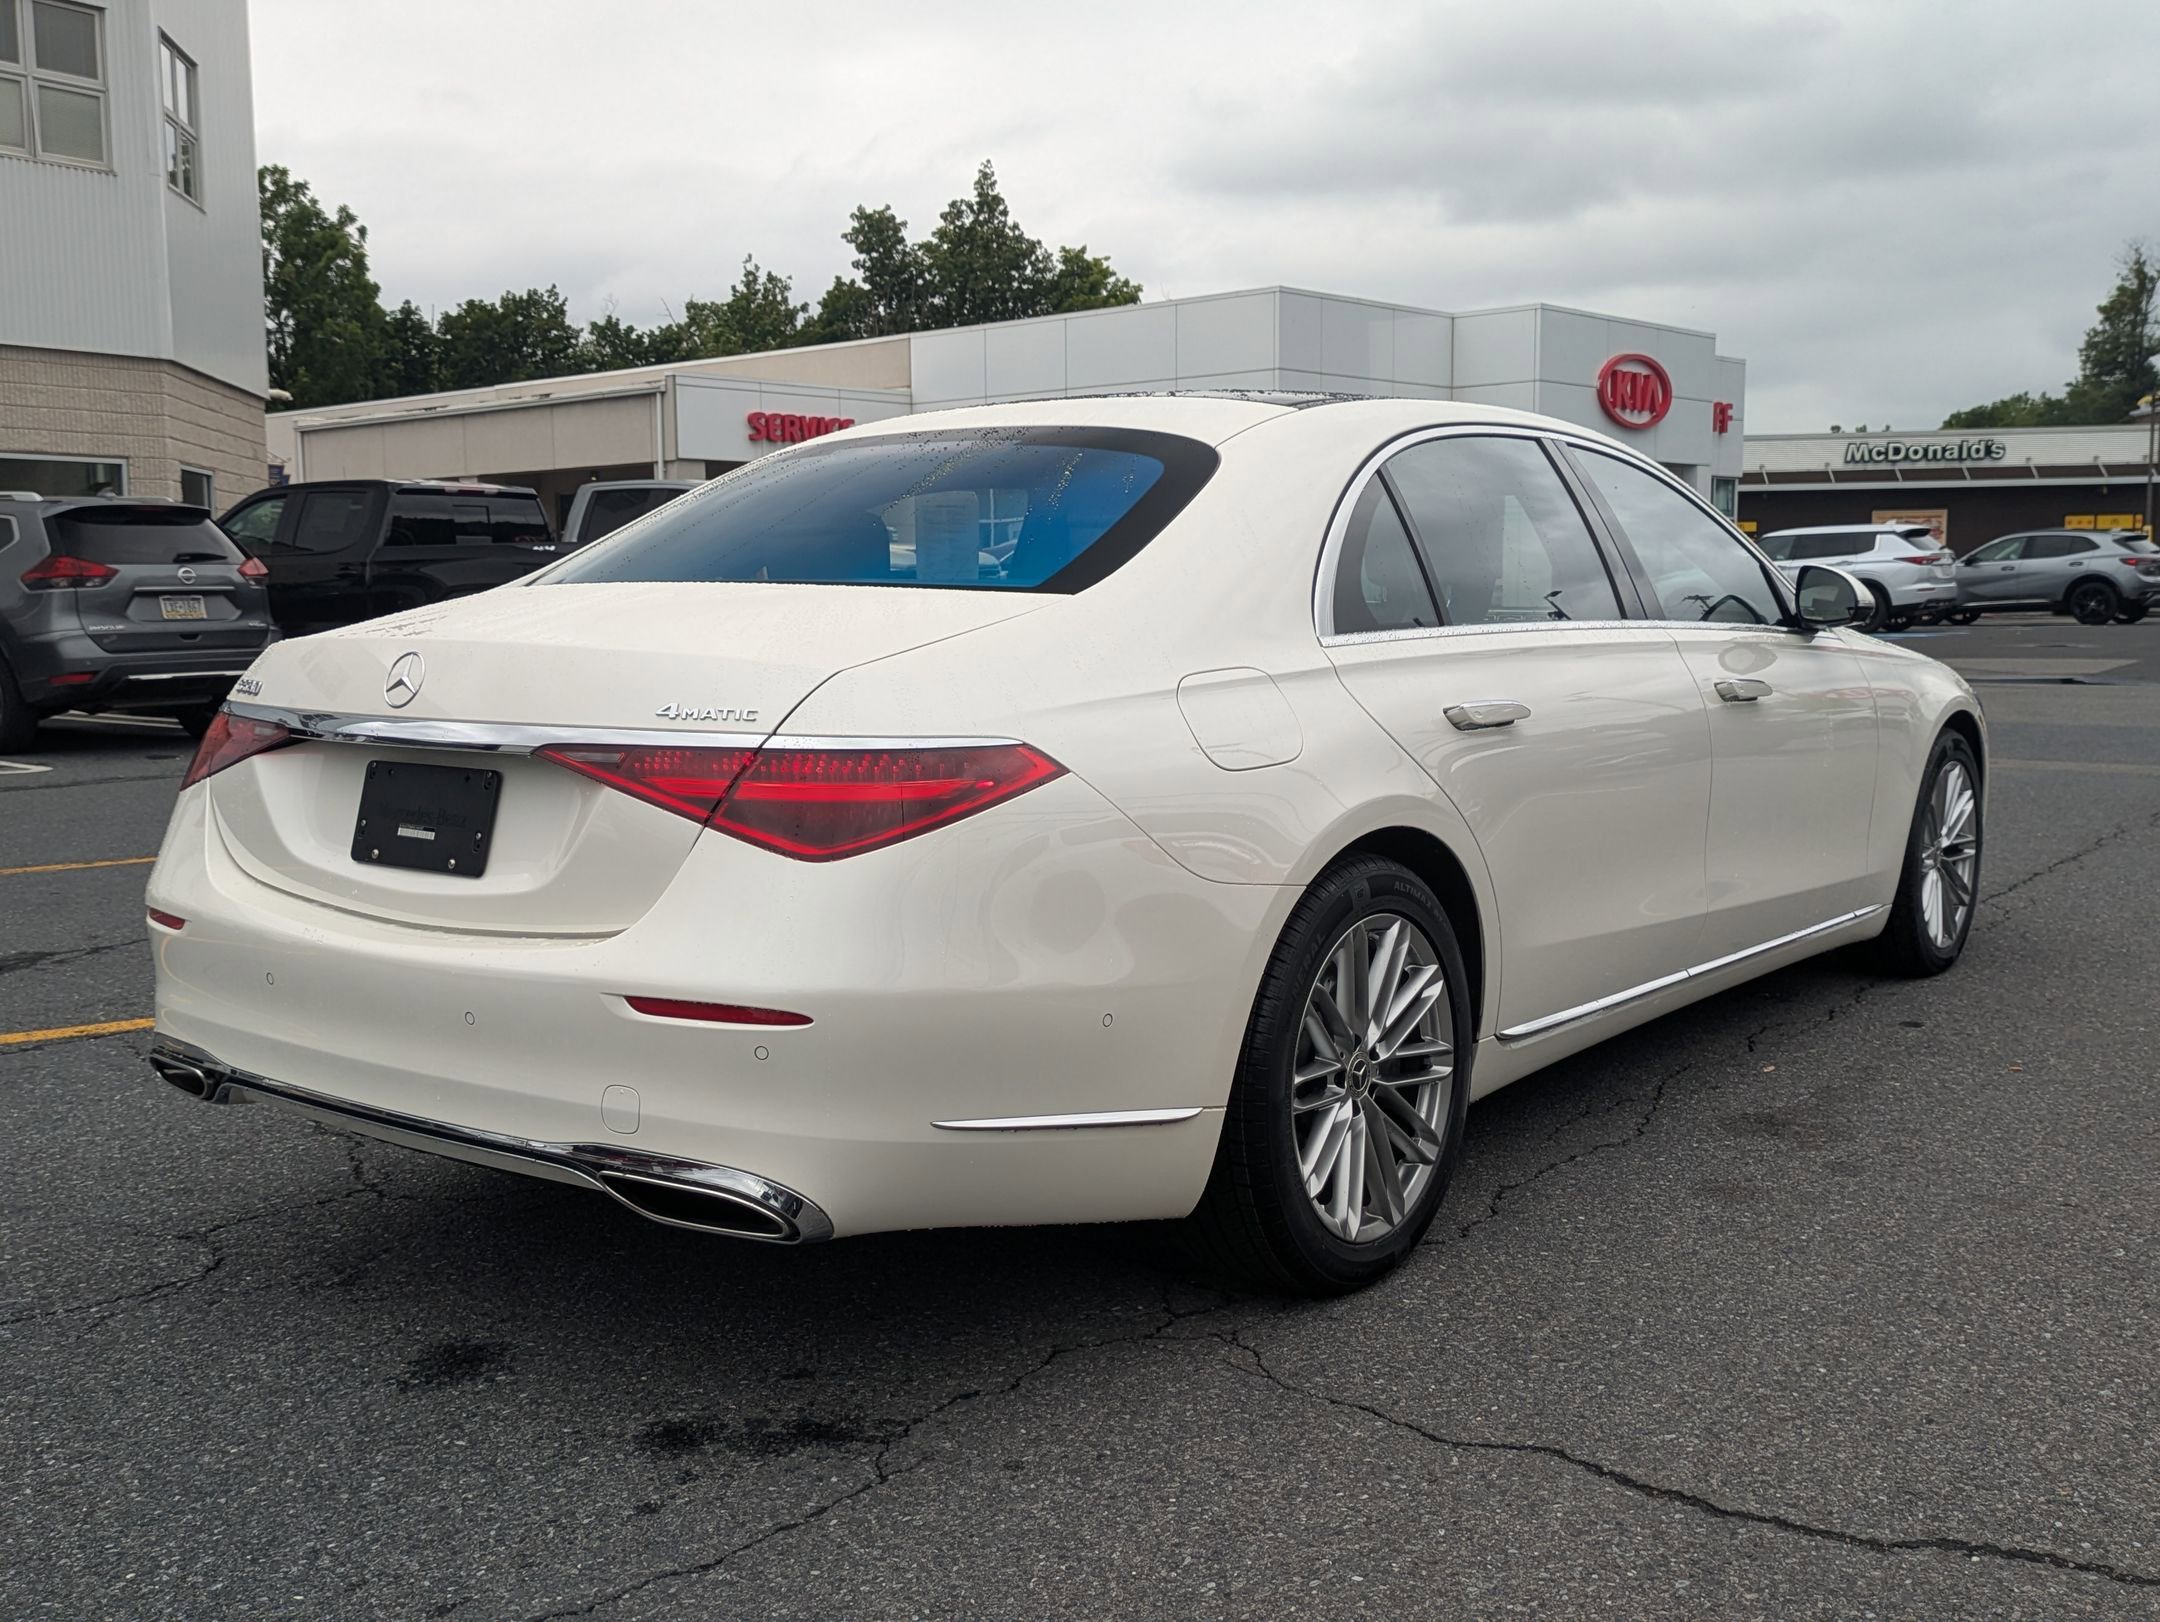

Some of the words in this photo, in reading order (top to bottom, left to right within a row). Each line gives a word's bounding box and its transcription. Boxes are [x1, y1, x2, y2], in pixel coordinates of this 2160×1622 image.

[1609, 370, 1661, 416] KIA
[1845, 440, 2006, 463] McDonald's
[656, 702, 759, 721] 4MATIC
